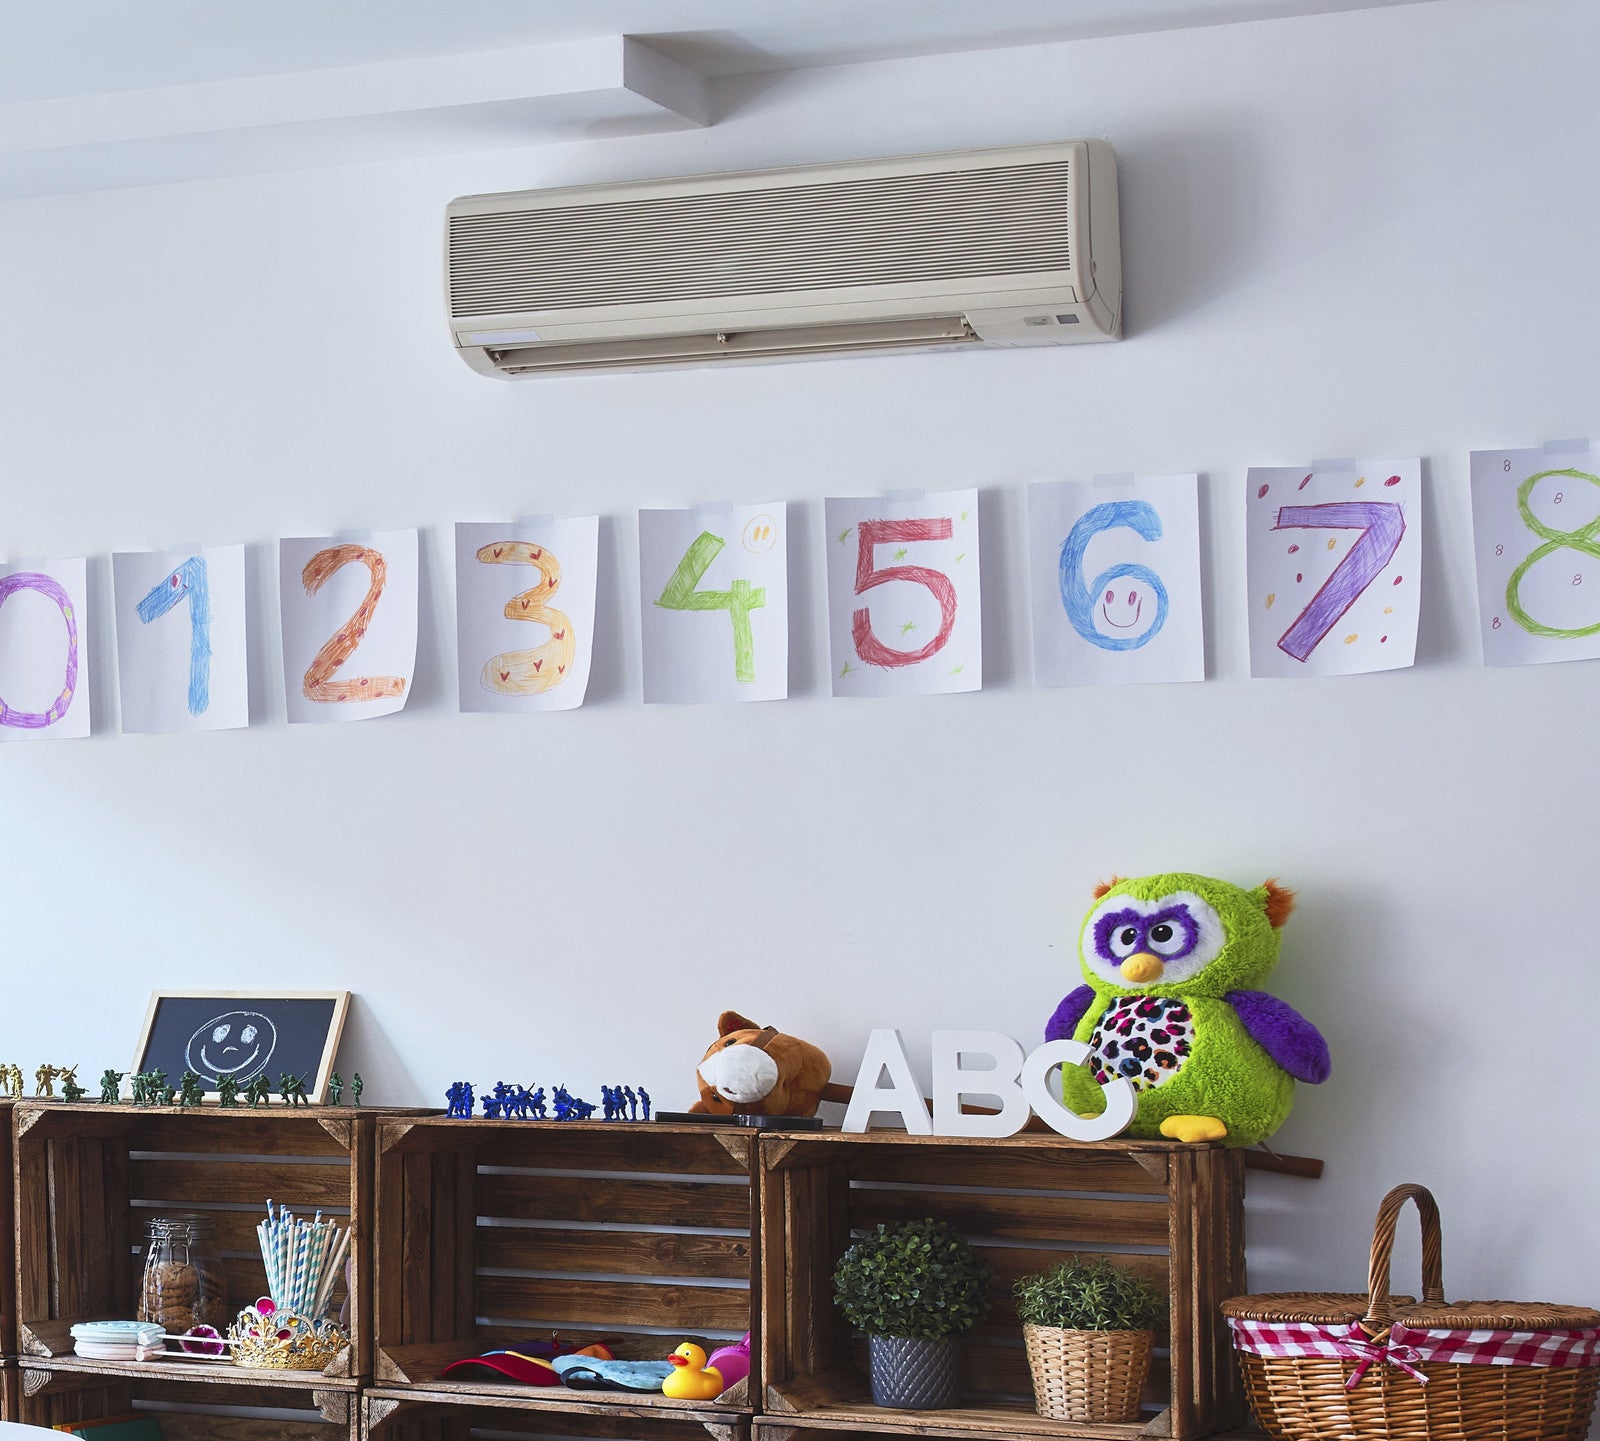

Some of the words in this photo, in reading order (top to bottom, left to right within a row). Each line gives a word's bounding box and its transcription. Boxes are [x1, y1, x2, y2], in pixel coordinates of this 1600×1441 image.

[302, 543, 406, 702] 2
[475, 540, 576, 696] 3
[654, 530, 766, 684] 4
[852, 517, 958, 668] 5
[1058, 499, 1169, 652] 6
[1268, 500, 1406, 663] 7
[1506, 467, 1600, 639] 8
[136, 555, 212, 716] 1
[841, 1028, 1138, 1142] ABC
